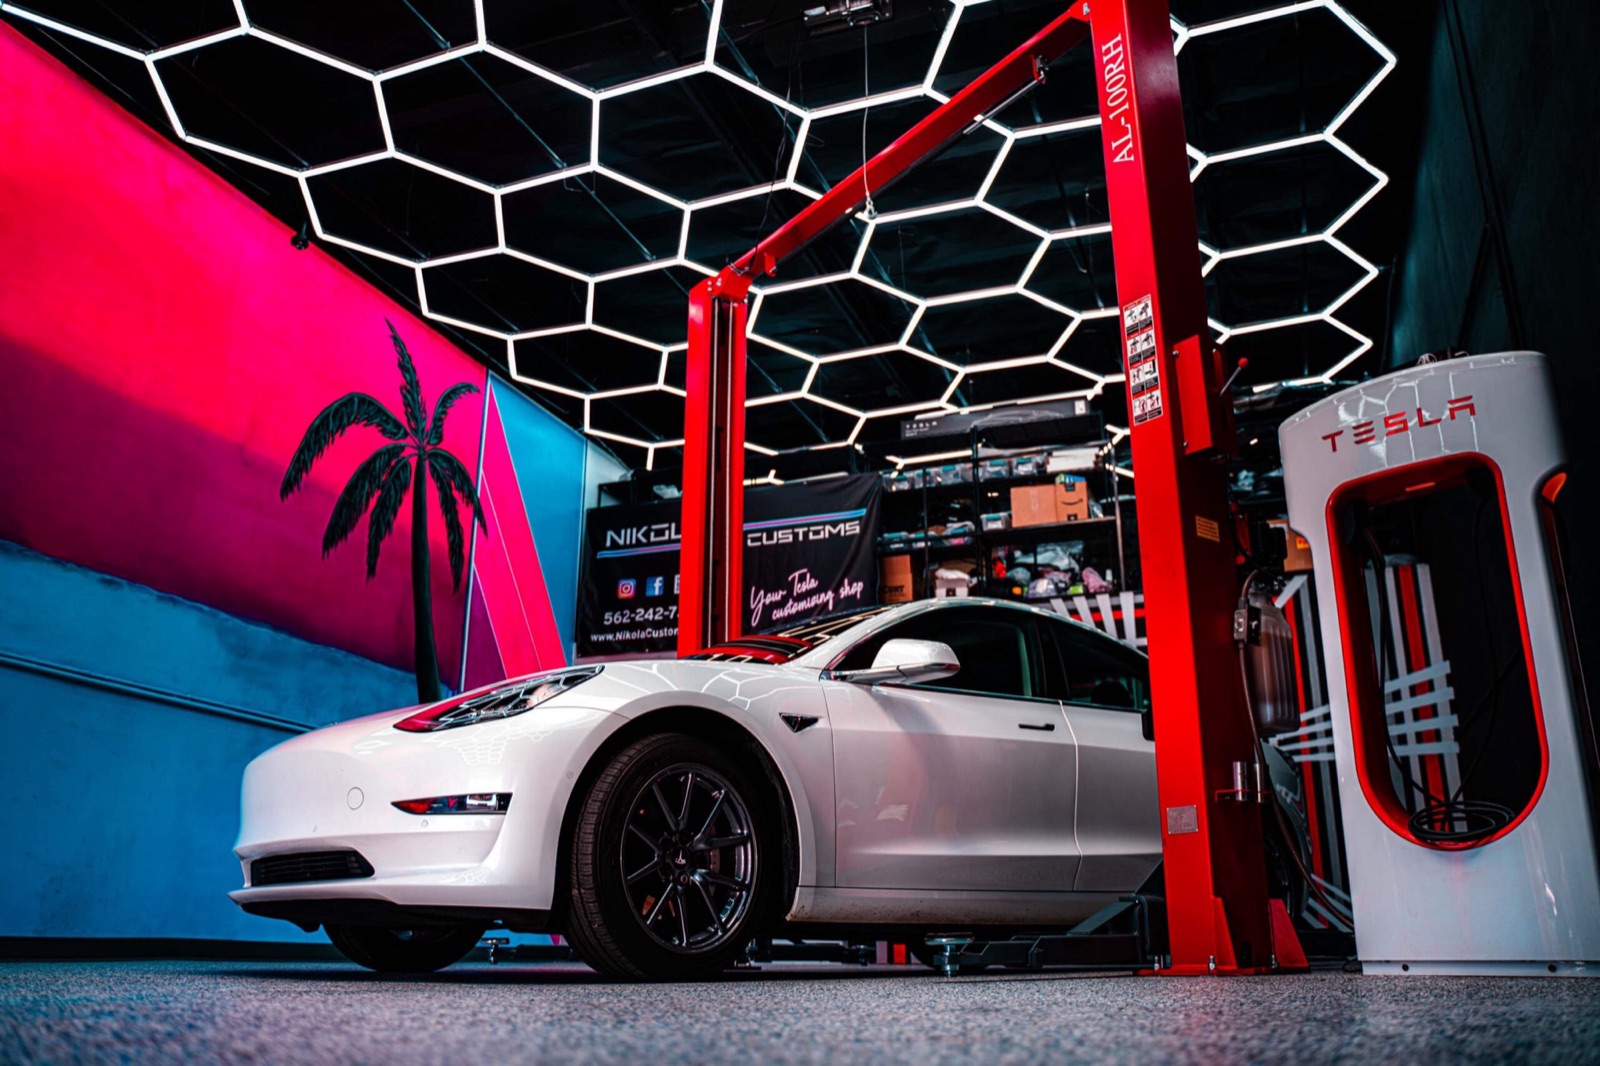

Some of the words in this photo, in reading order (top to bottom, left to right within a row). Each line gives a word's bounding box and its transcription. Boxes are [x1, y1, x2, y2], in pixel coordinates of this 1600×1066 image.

[1101, 33, 1135, 163] AL-100RH
[1321, 395, 1476, 453] TESLA
[746, 520, 861, 547] CUSTOMS
[750, 586, 787, 627] Your
[788, 568, 819, 596] Tesla
[839, 578, 864, 599] shop
[603, 605, 680, 625] 562-242-7
